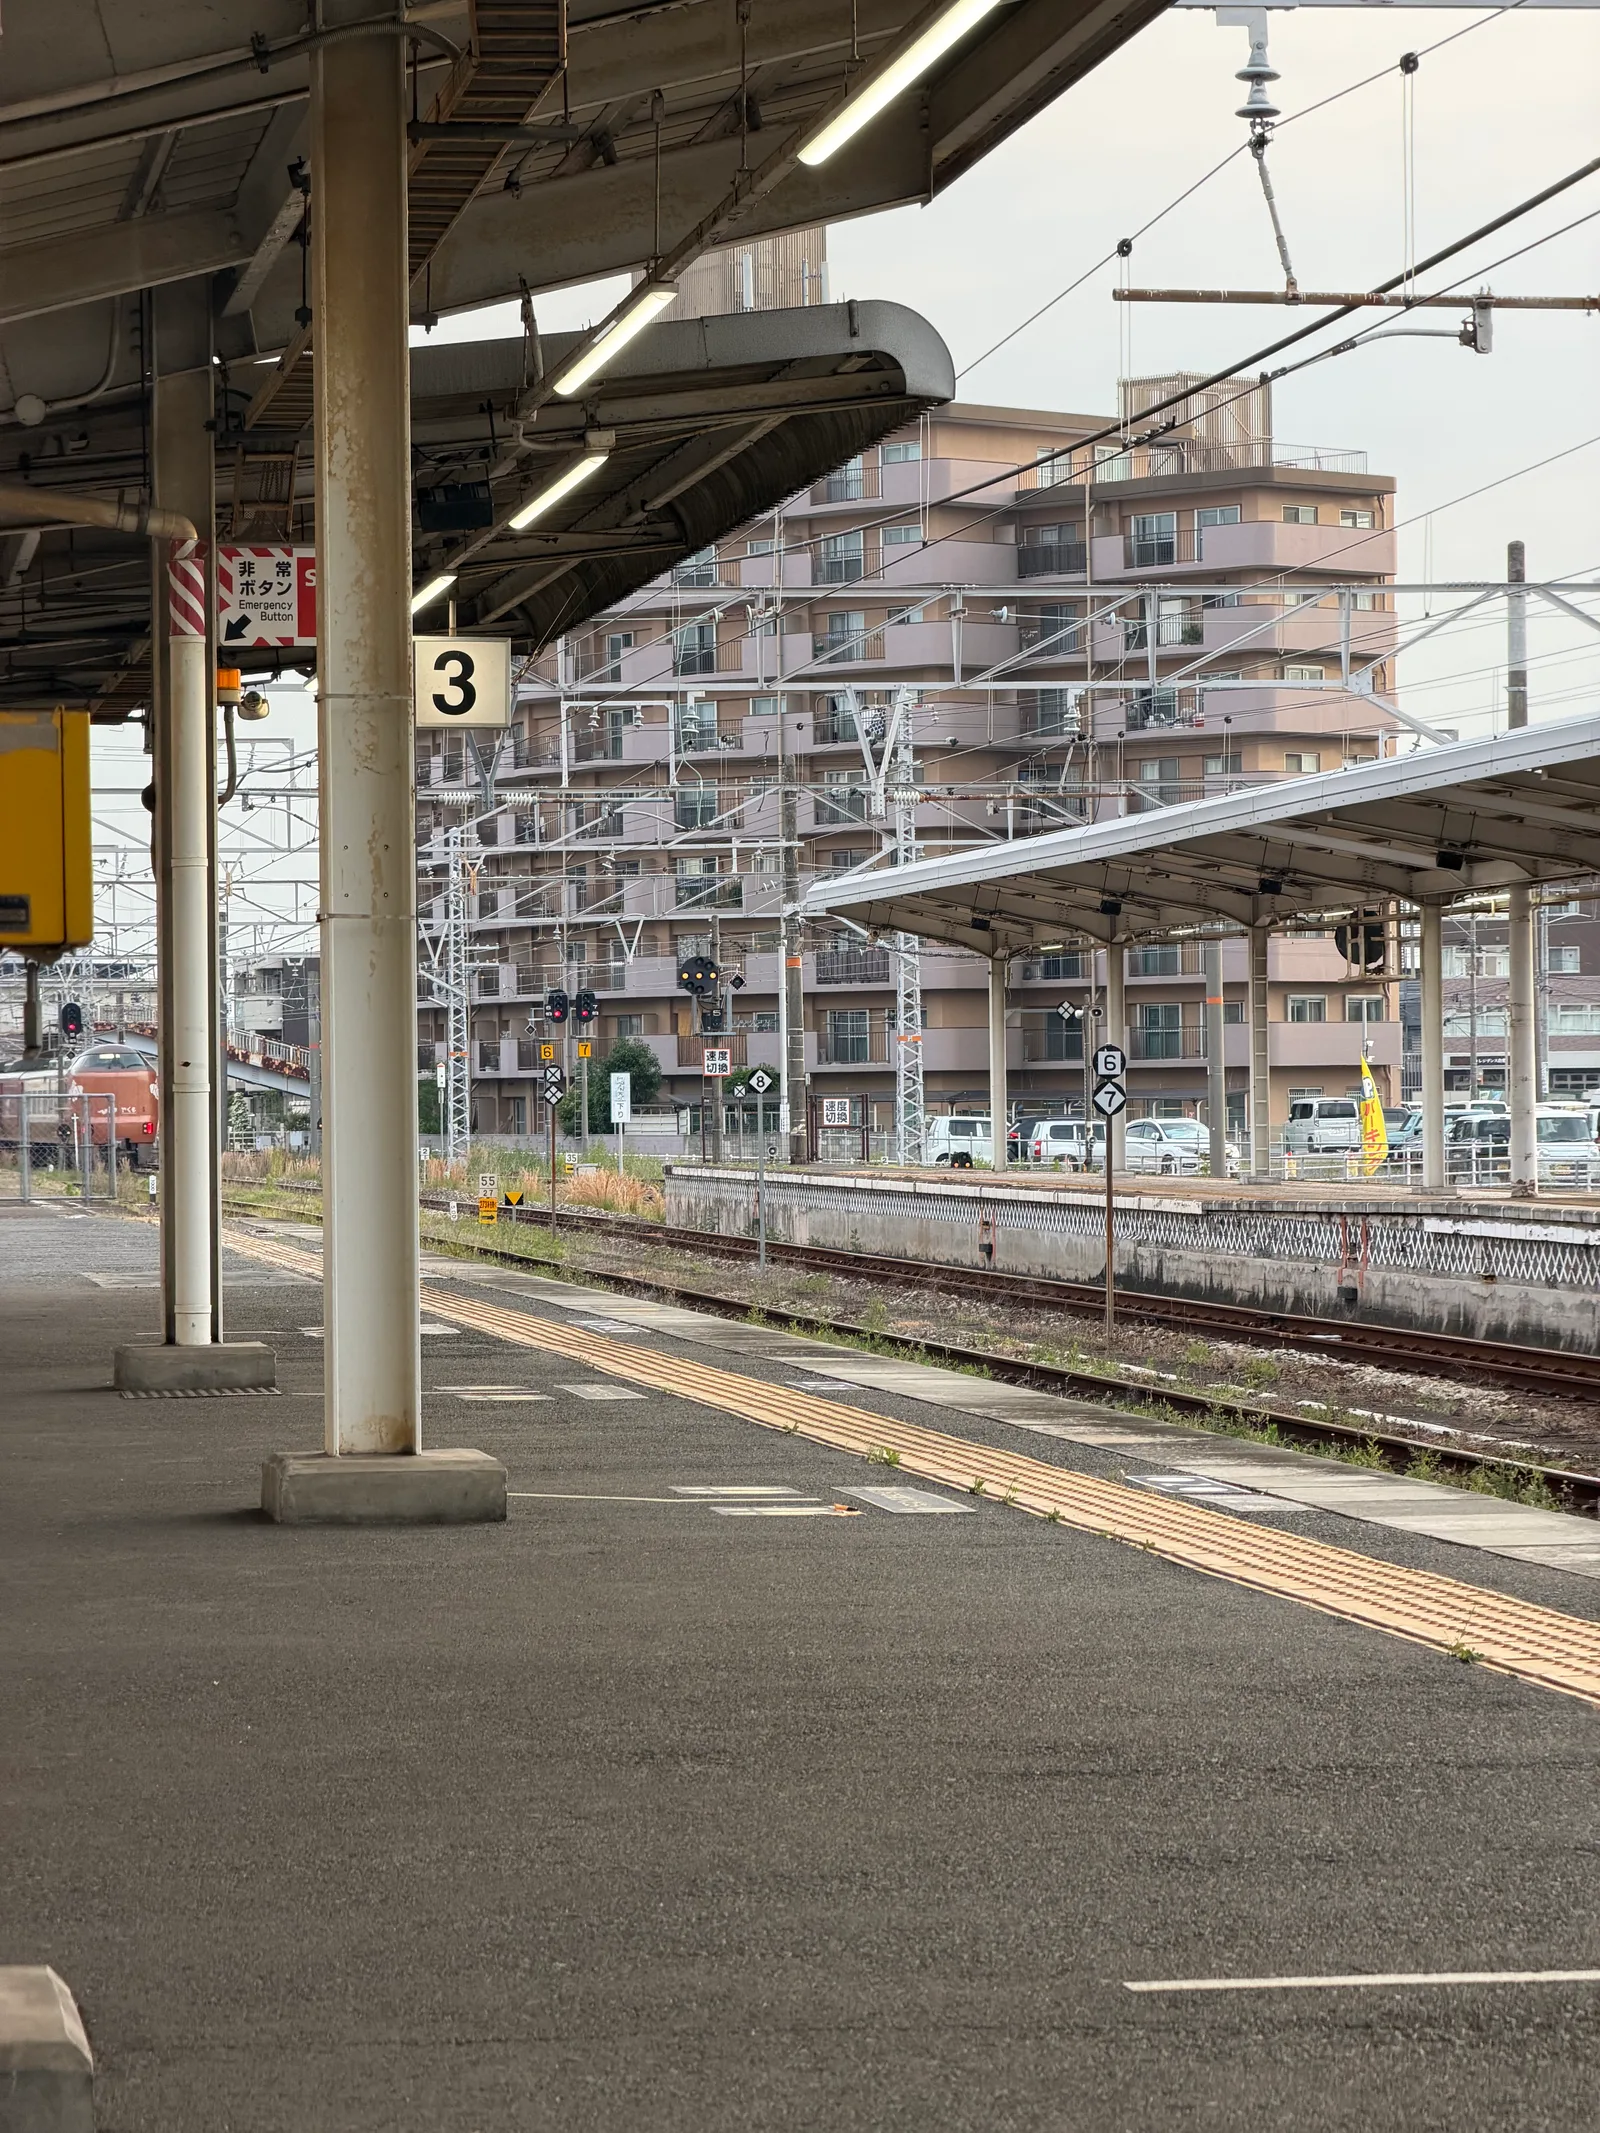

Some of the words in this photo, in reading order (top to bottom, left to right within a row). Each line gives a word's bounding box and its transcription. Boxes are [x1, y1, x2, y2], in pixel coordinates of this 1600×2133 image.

[239, 561, 291, 577] 非常
[240, 580, 292, 596] ボタン
[239, 600, 293, 610] Emergency
[260, 611, 293, 621] Button
[432, 650, 477, 716] 3
[543, 1046, 551, 1058] 6
[580, 1044, 589, 1056] 7
[706, 1050, 728, 1061] 速度
[706, 1062, 728, 1073] 切換
[1104, 1055, 1117, 1071] 6
[756, 1075, 765, 1088] 8
[1104, 1091, 1116, 1108] 7
[826, 1101, 847, 1111] 速度
[826, 1112, 847, 1123] 切換
[566, 1153, 577, 1163] 35
[481, 1176, 495, 1187] 55
[483, 1189, 494, 1197] 27
